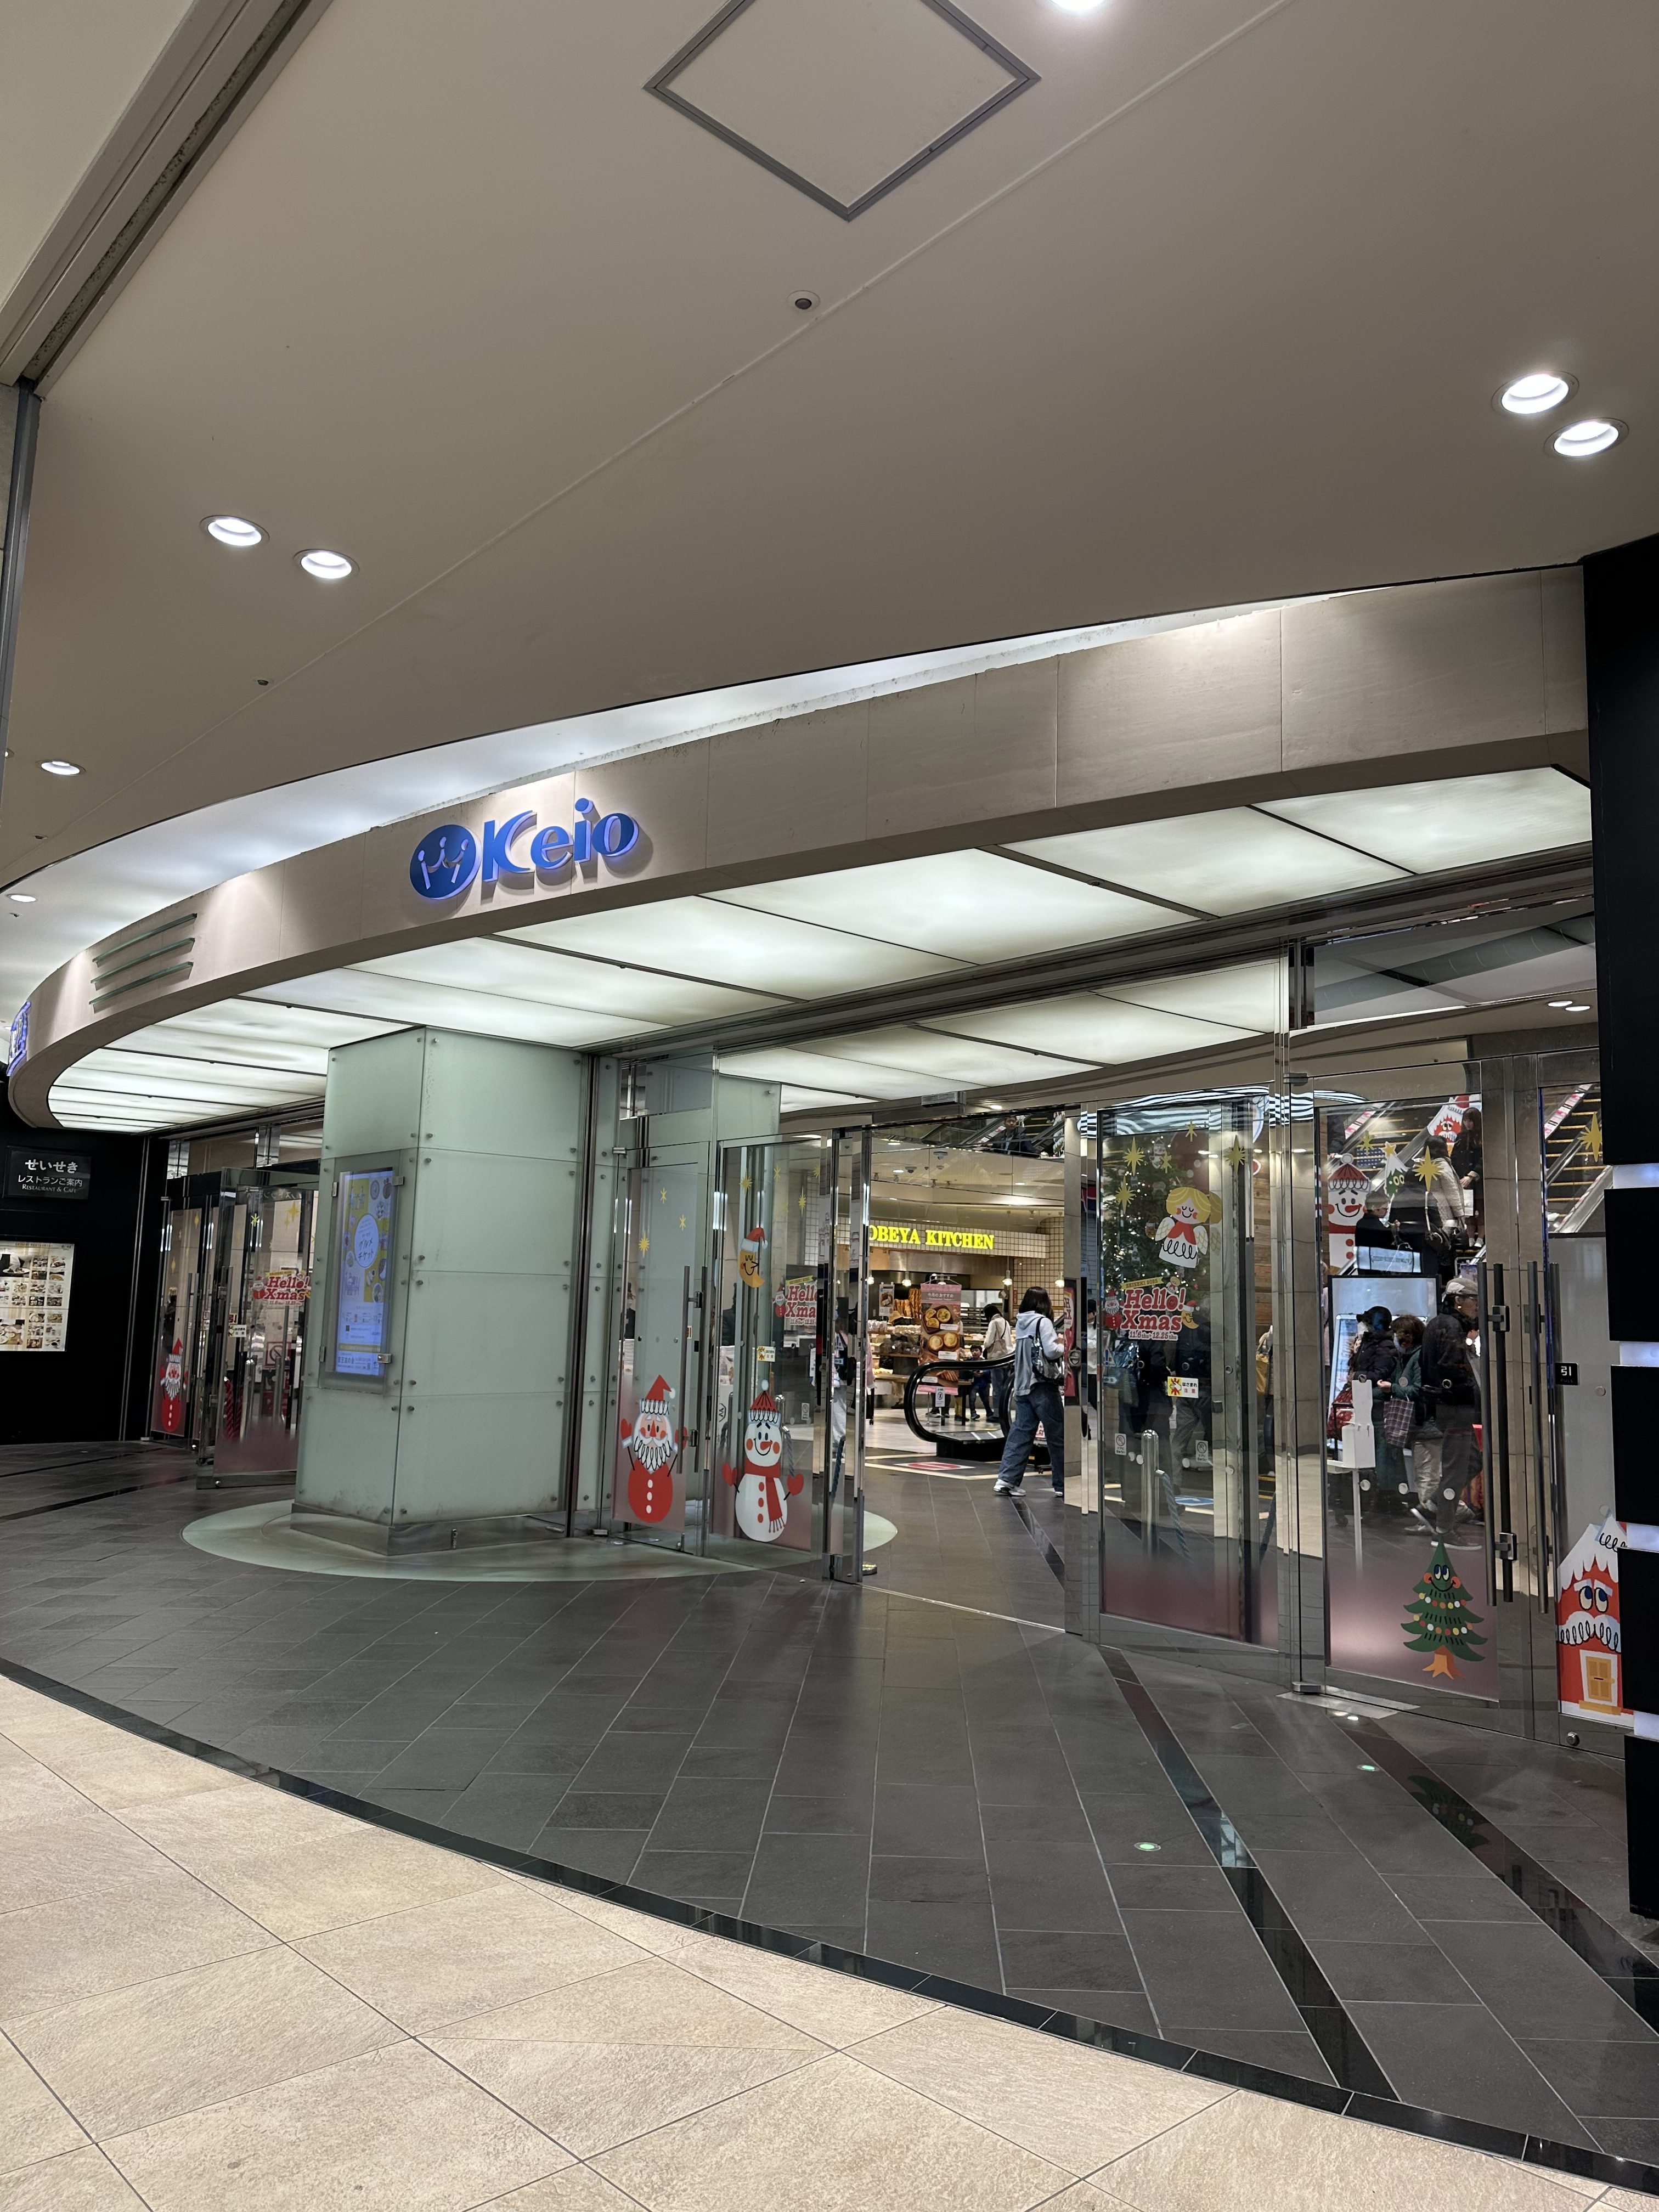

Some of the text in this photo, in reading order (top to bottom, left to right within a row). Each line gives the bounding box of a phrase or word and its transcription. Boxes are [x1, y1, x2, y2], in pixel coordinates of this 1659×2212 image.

[481, 798, 639, 882] Keio
[25, 1159, 78, 1173] せいせき
[18, 1175, 82, 1187] レストランご案内
[926, 1229, 995, 1249] KITCHEN
[267, 1276, 309, 1289] Hello!
[264, 1288, 305, 1300] Xmas
[1125, 1289, 1186, 1310] Hello!
[1121, 1310, 1182, 1331] Xmas
[1561, 1366, 1572, 1376] 引
